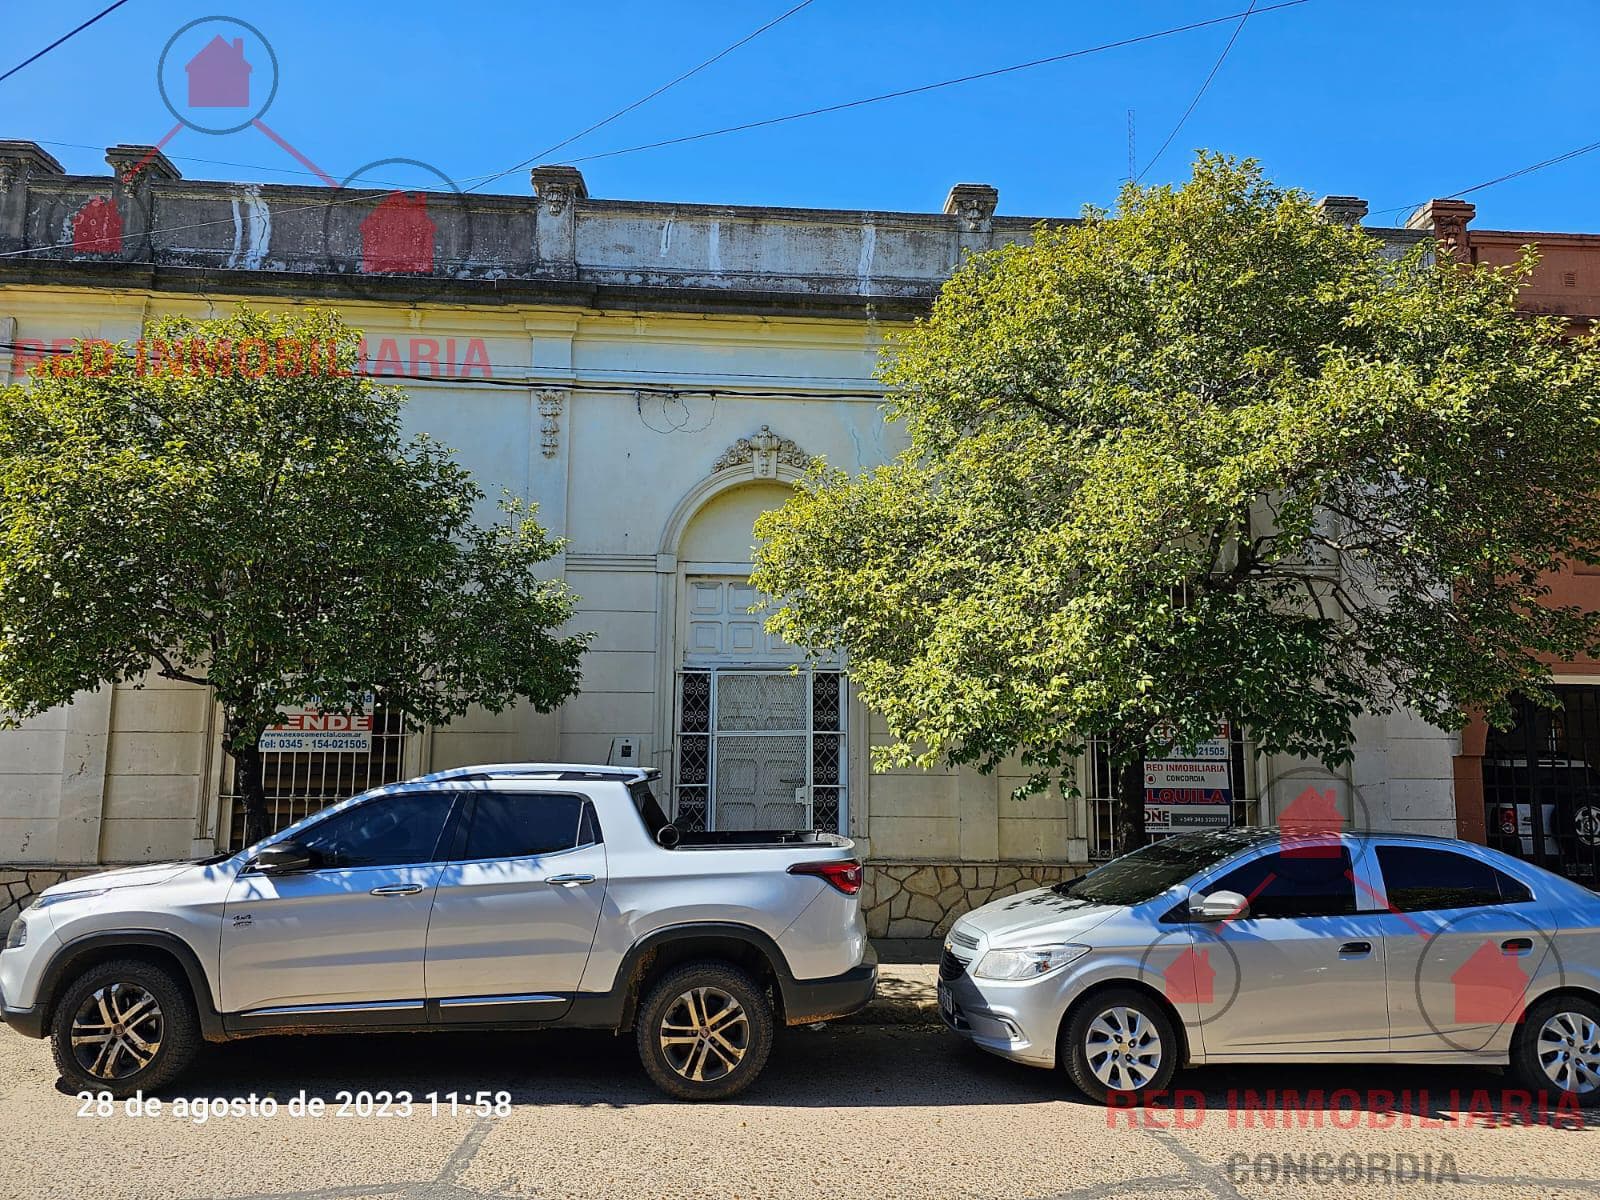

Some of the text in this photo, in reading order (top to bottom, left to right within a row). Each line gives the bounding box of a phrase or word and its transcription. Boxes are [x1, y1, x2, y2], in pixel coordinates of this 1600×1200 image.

[265, 715, 369, 730] ENDE
[260, 740, 276, 748] Tel:
[279, 740, 303, 748] 0345
[1146, 764, 1225, 773] RED INMOBILIARIA
[1144, 788, 1227, 804] LQUILA
